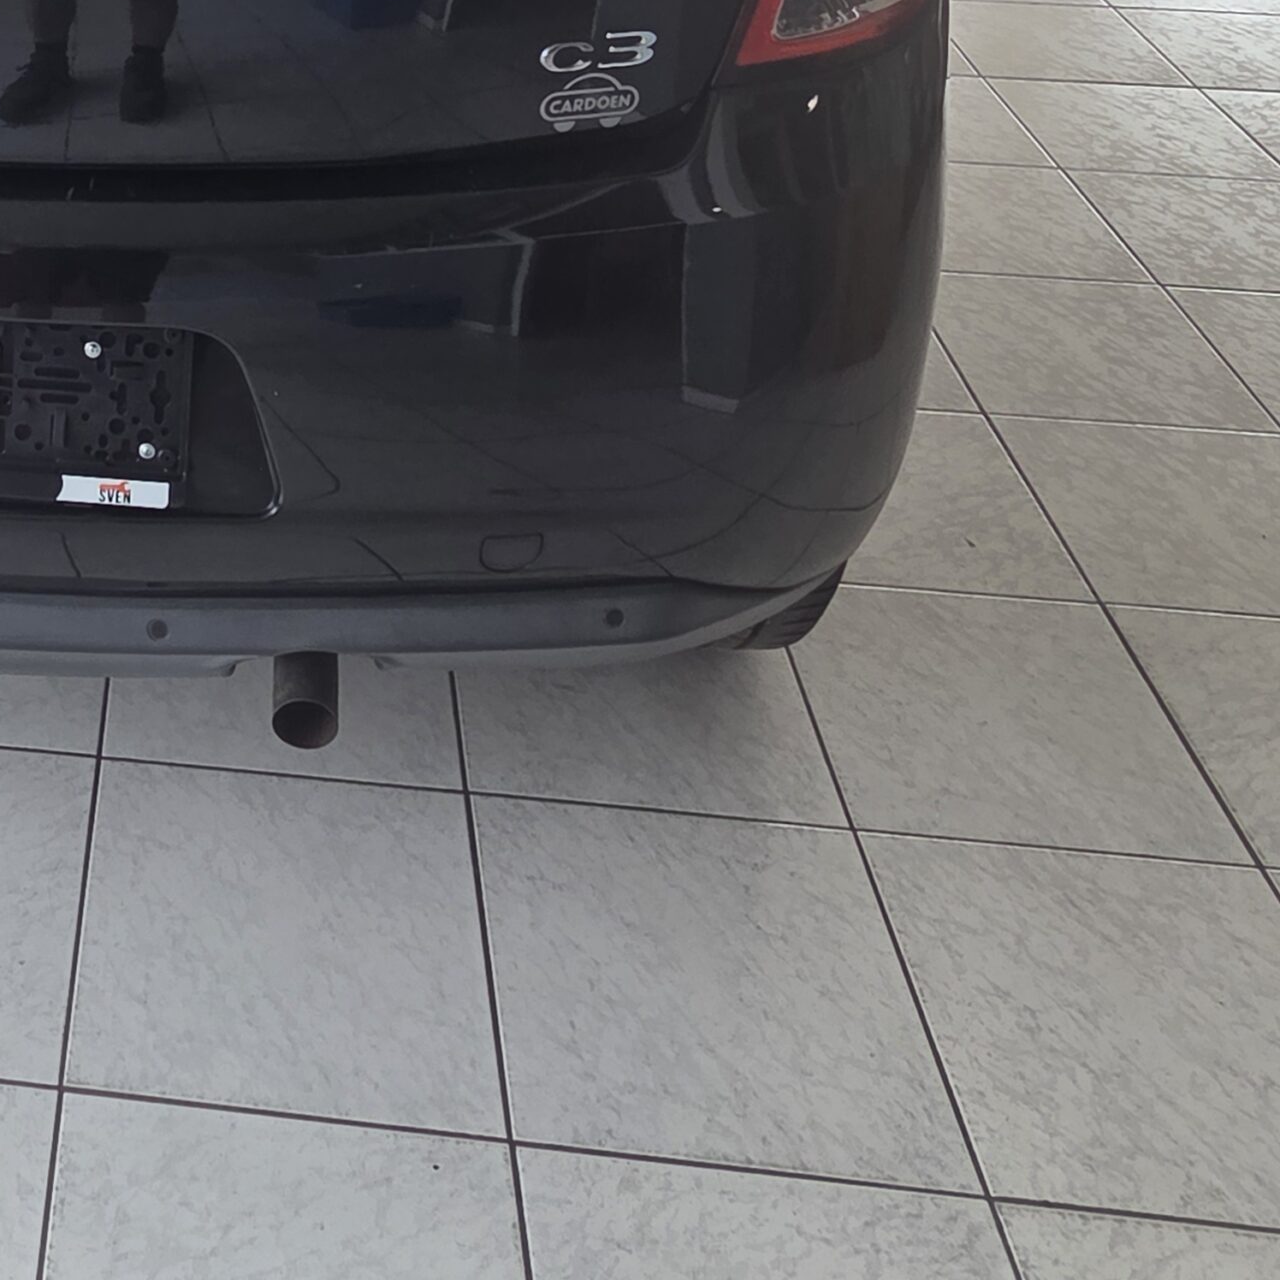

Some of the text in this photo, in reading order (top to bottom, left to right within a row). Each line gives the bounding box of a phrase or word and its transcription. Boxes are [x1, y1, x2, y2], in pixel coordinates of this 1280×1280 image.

[539, 31, 657, 72] C3
[549, 94, 631, 114] CARDOEN
[99, 488, 131, 504] SVEN
